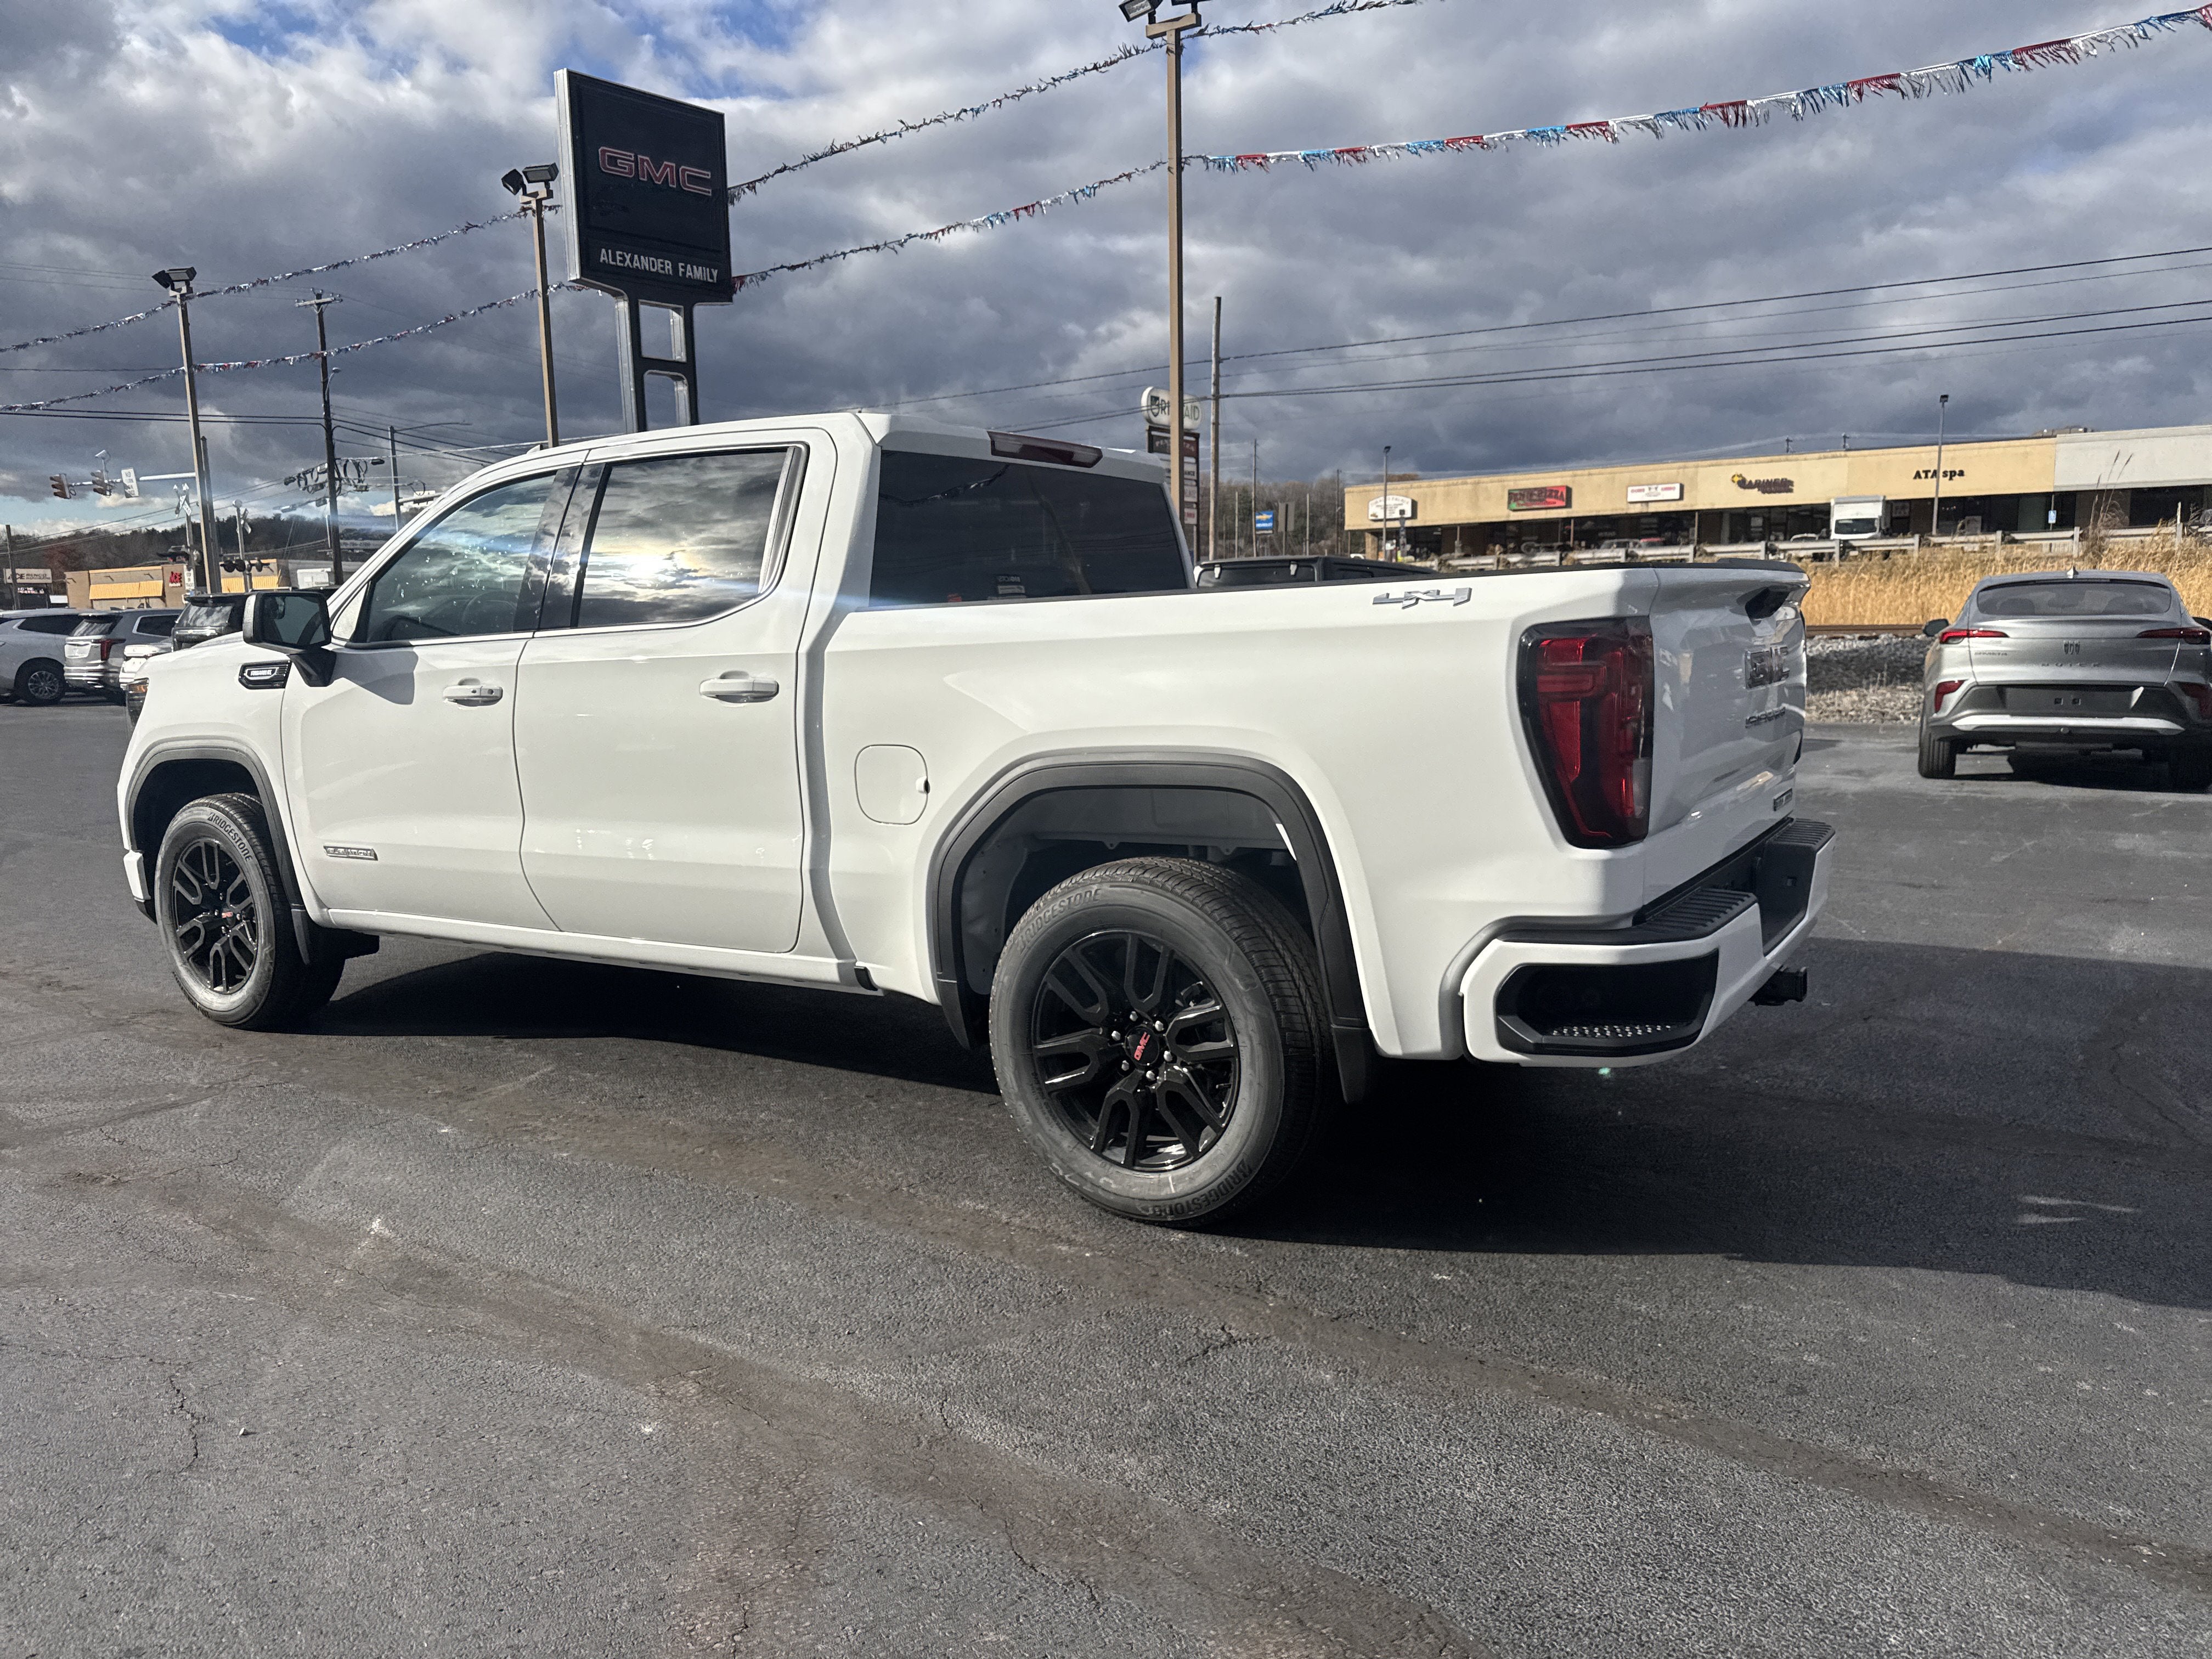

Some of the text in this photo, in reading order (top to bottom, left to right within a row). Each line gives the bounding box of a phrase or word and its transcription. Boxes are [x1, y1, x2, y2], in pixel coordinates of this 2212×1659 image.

[599, 146, 712, 196] GMC
[600, 248, 719, 283] ALEXANDER FAMILY
[1184, 404, 1200, 421] AID
[1913, 469, 1965, 481] ATA spa
[207, 812, 252, 862] BRIDGESTONE
[1016, 888, 1102, 953] BRIDGESTONE
[1134, 1031, 1150, 1061] GMC
[1152, 1158, 1253, 1217] BRIDGESTONE
